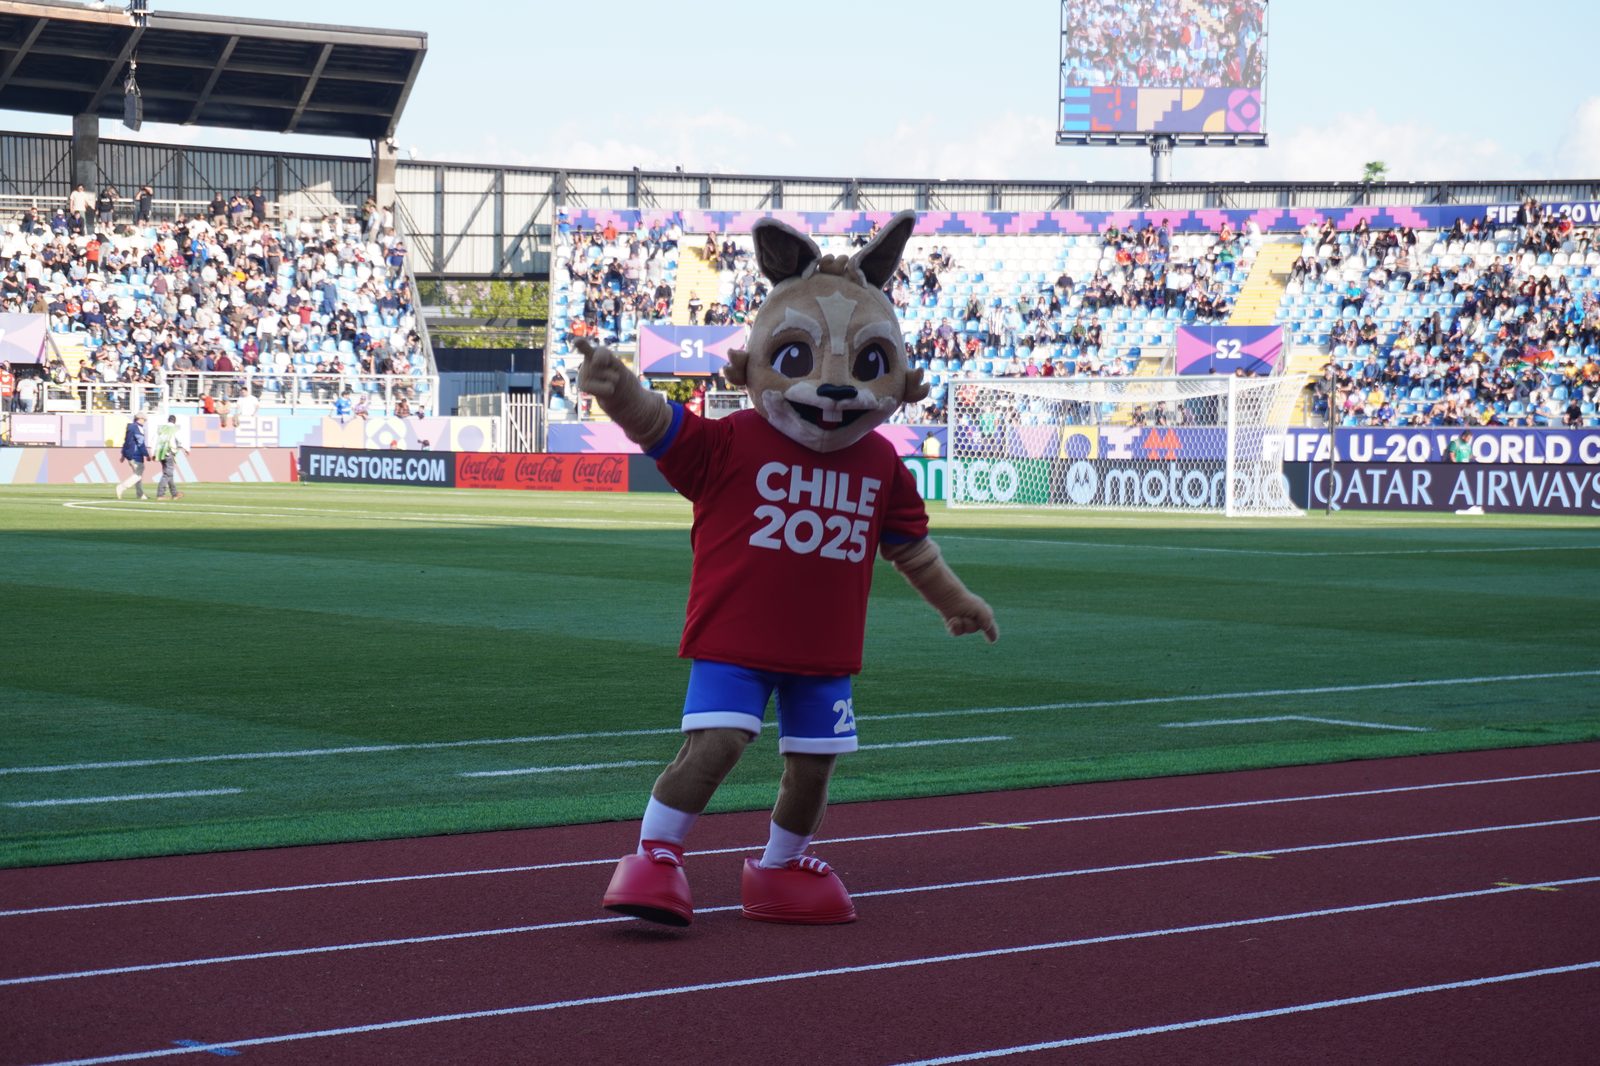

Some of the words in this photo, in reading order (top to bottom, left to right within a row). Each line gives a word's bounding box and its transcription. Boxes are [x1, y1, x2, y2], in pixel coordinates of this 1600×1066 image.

[680, 339, 704, 358] S1
[1216, 339, 1242, 359] S2
[1263, 433, 1341, 462] FIFA
[1350, 434, 1430, 463] U-20
[310, 454, 446, 482] FIFASTORE.COM
[755, 461, 882, 517] CHILE
[1314, 468, 1433, 511] QATAR
[749, 505, 870, 563] 2025
